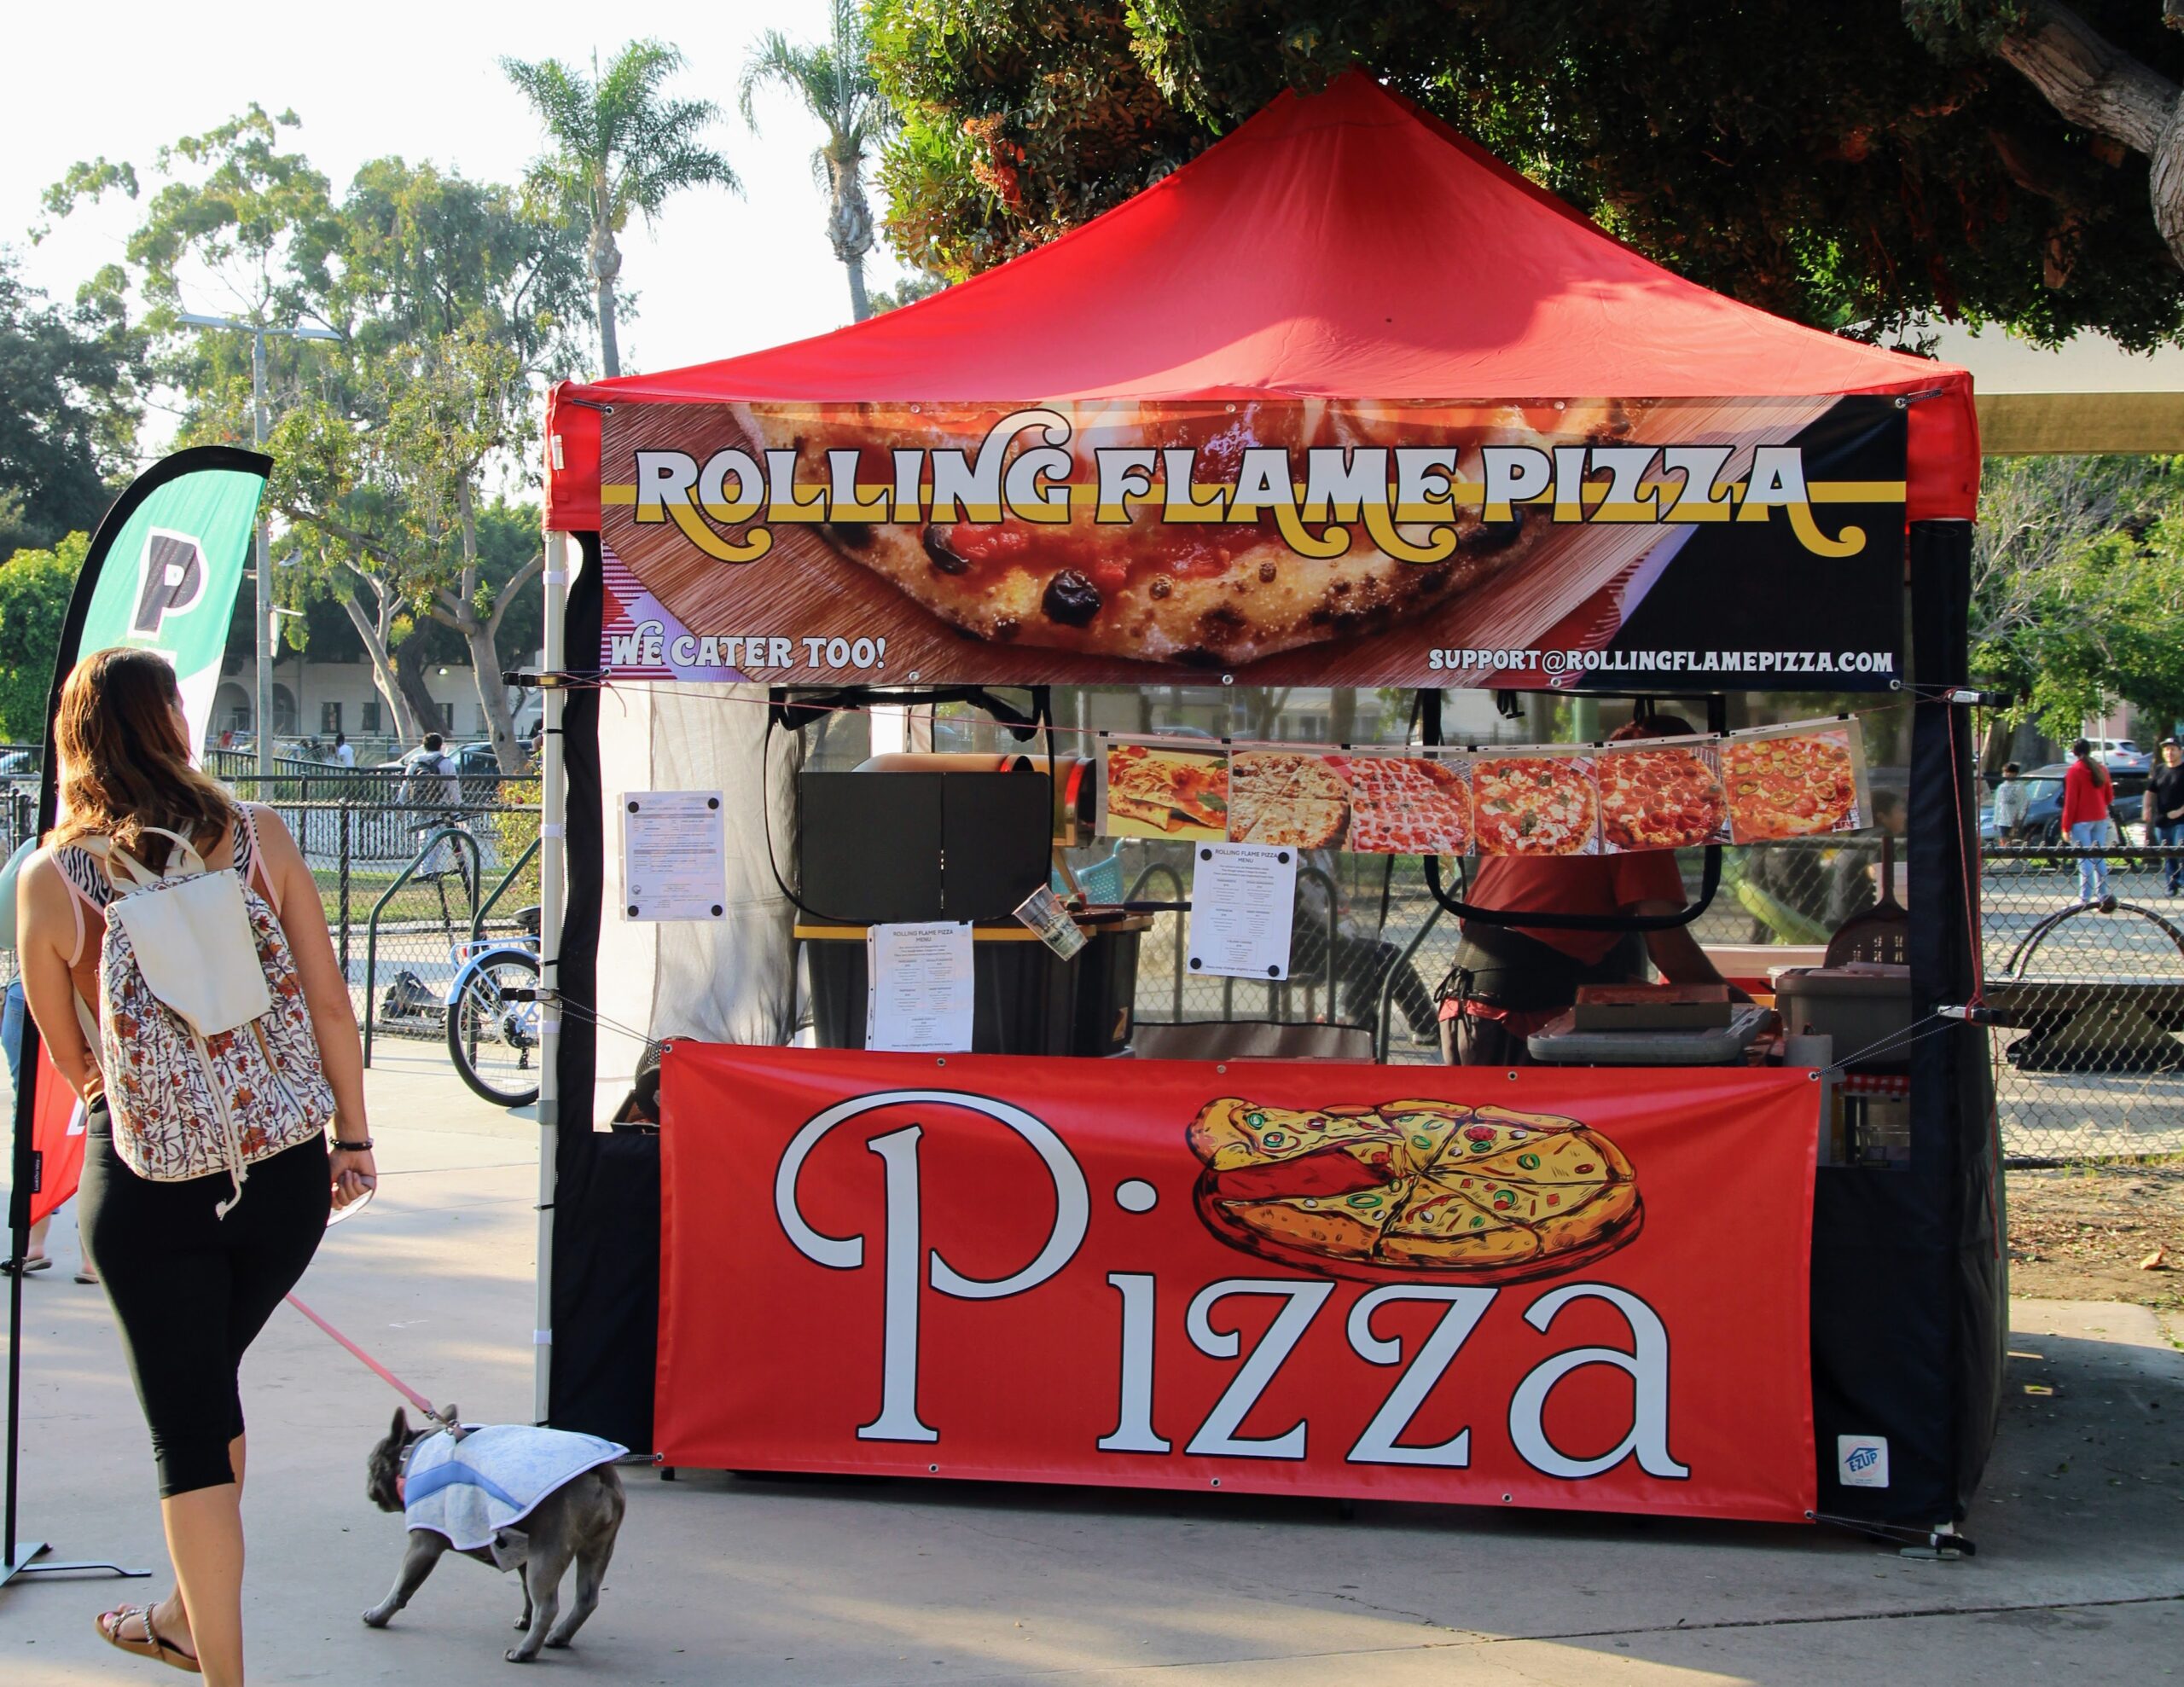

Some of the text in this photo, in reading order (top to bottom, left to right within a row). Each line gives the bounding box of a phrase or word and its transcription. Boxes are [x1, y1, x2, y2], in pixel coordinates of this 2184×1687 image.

[633, 407, 1867, 564] ROLLING FLAME PIZZA
[610, 620, 887, 670] WE CATER TOO!
[1428, 648, 1894, 675] SUPPORT@ROLLINGFLAMEPIZZA.COM
[772, 1090, 1690, 1481] Pizza
